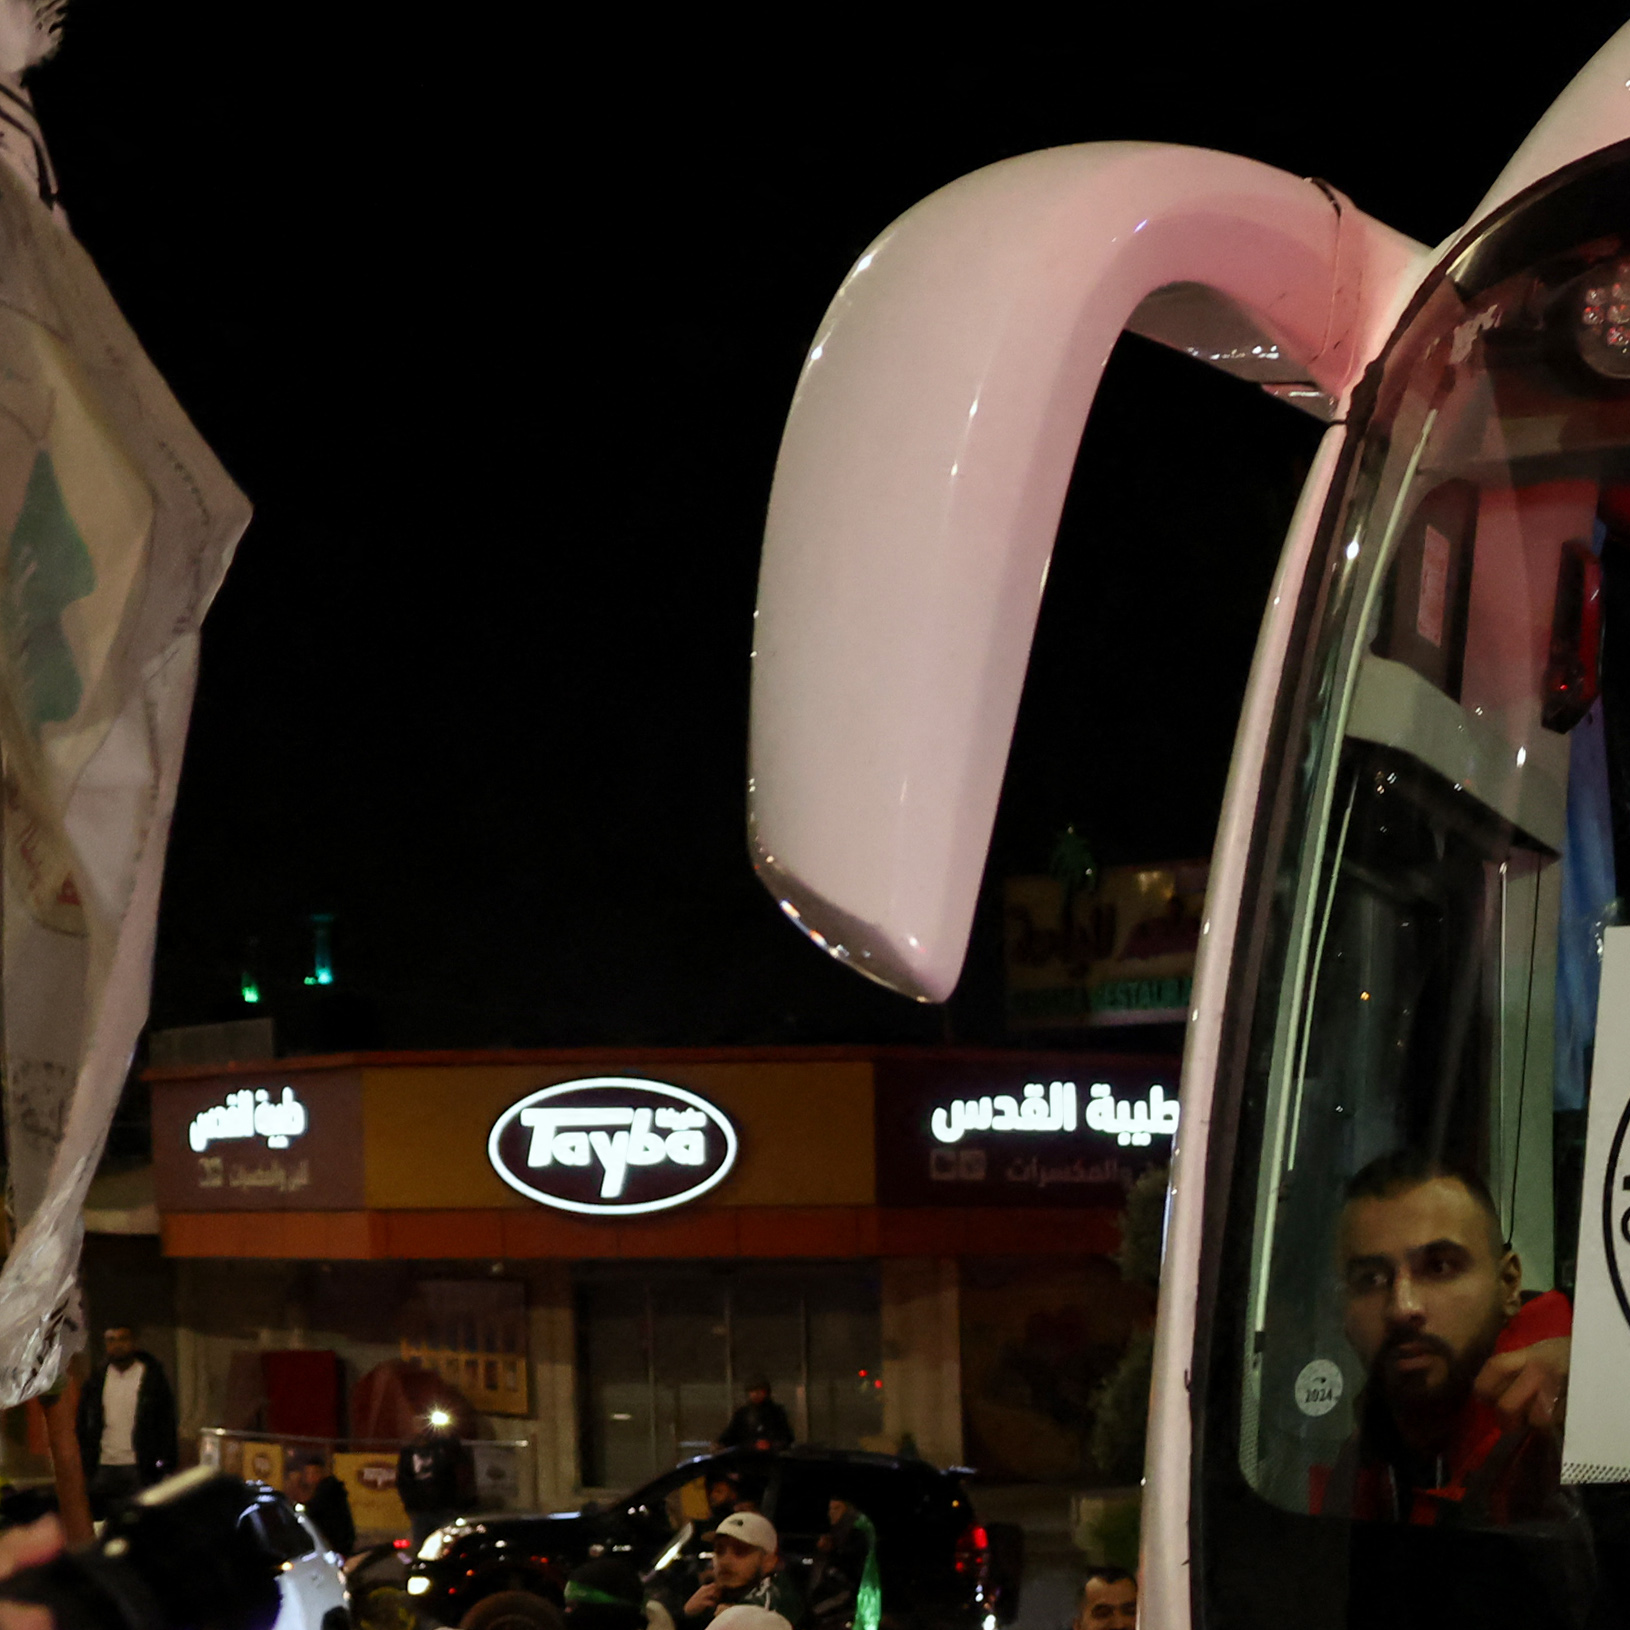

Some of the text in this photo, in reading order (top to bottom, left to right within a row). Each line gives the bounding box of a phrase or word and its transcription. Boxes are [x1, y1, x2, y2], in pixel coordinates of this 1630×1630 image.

[520, 1107, 707, 1200] Tayba
[931, 1080, 1180, 1149] طيبة القدس
